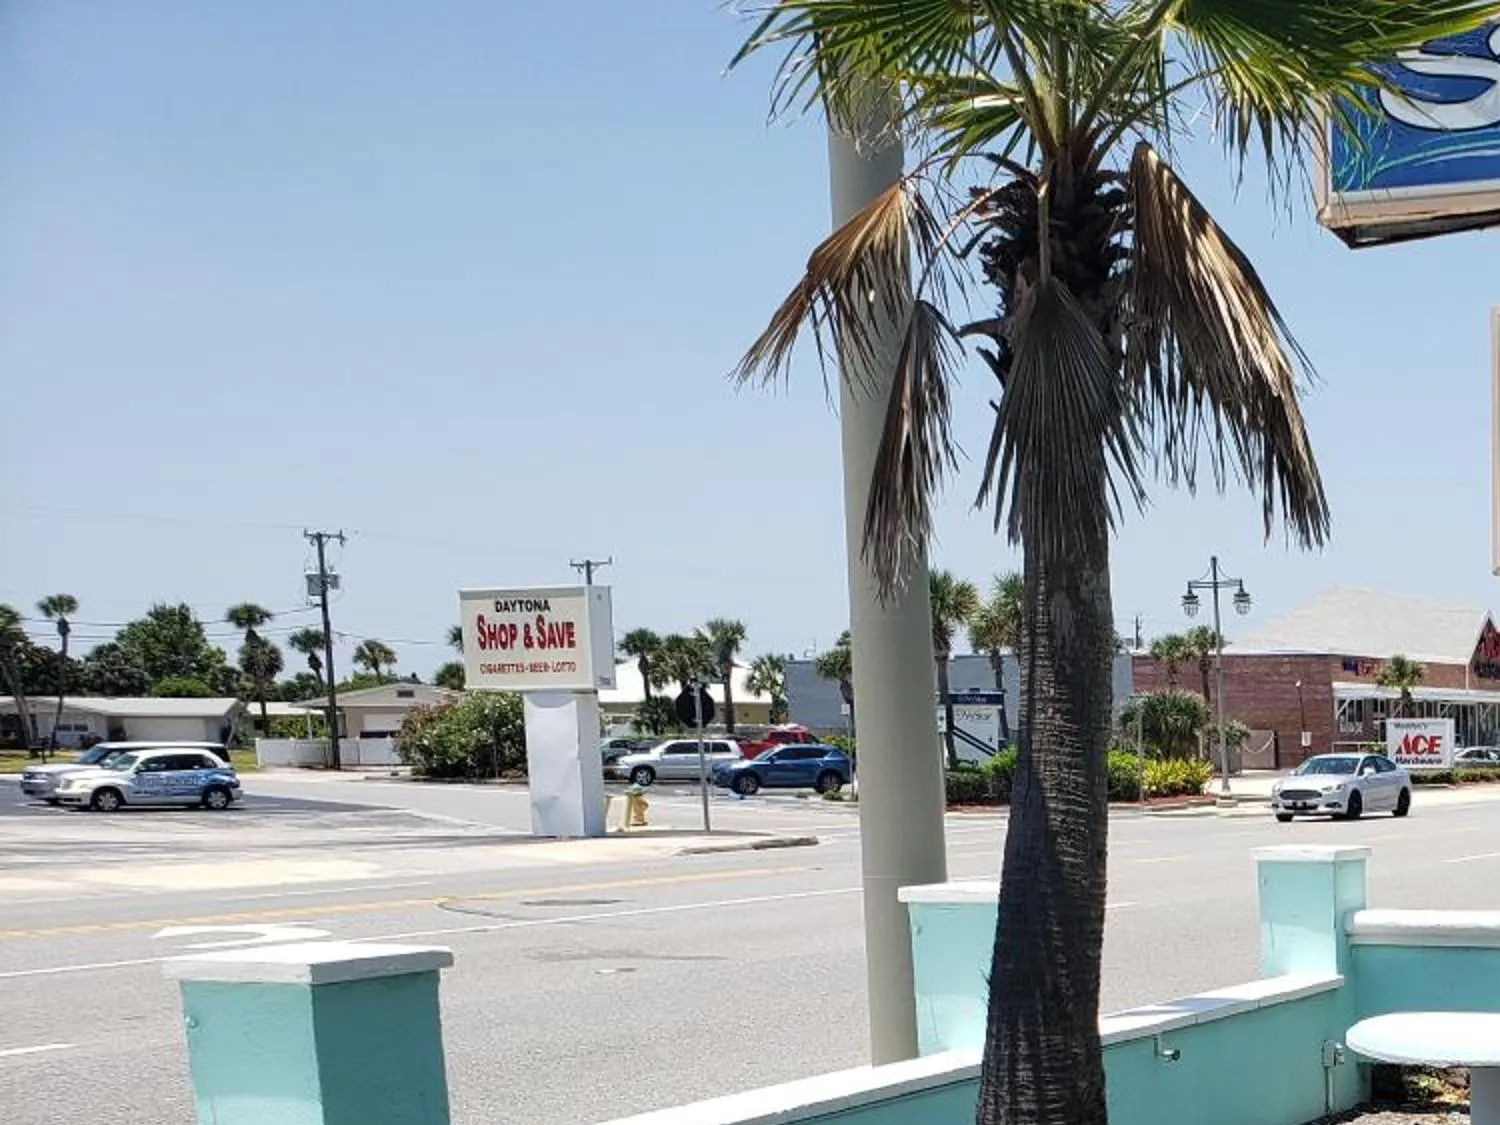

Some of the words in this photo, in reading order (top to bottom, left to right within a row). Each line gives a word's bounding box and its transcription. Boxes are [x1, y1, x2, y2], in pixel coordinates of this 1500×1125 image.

[495, 599, 551, 613] DAYTONA
[477, 613, 518, 650] SHOP
[523, 623, 535, 650] &
[535, 613, 577, 650] SAVE
[1395, 732, 1443, 755] ACE
